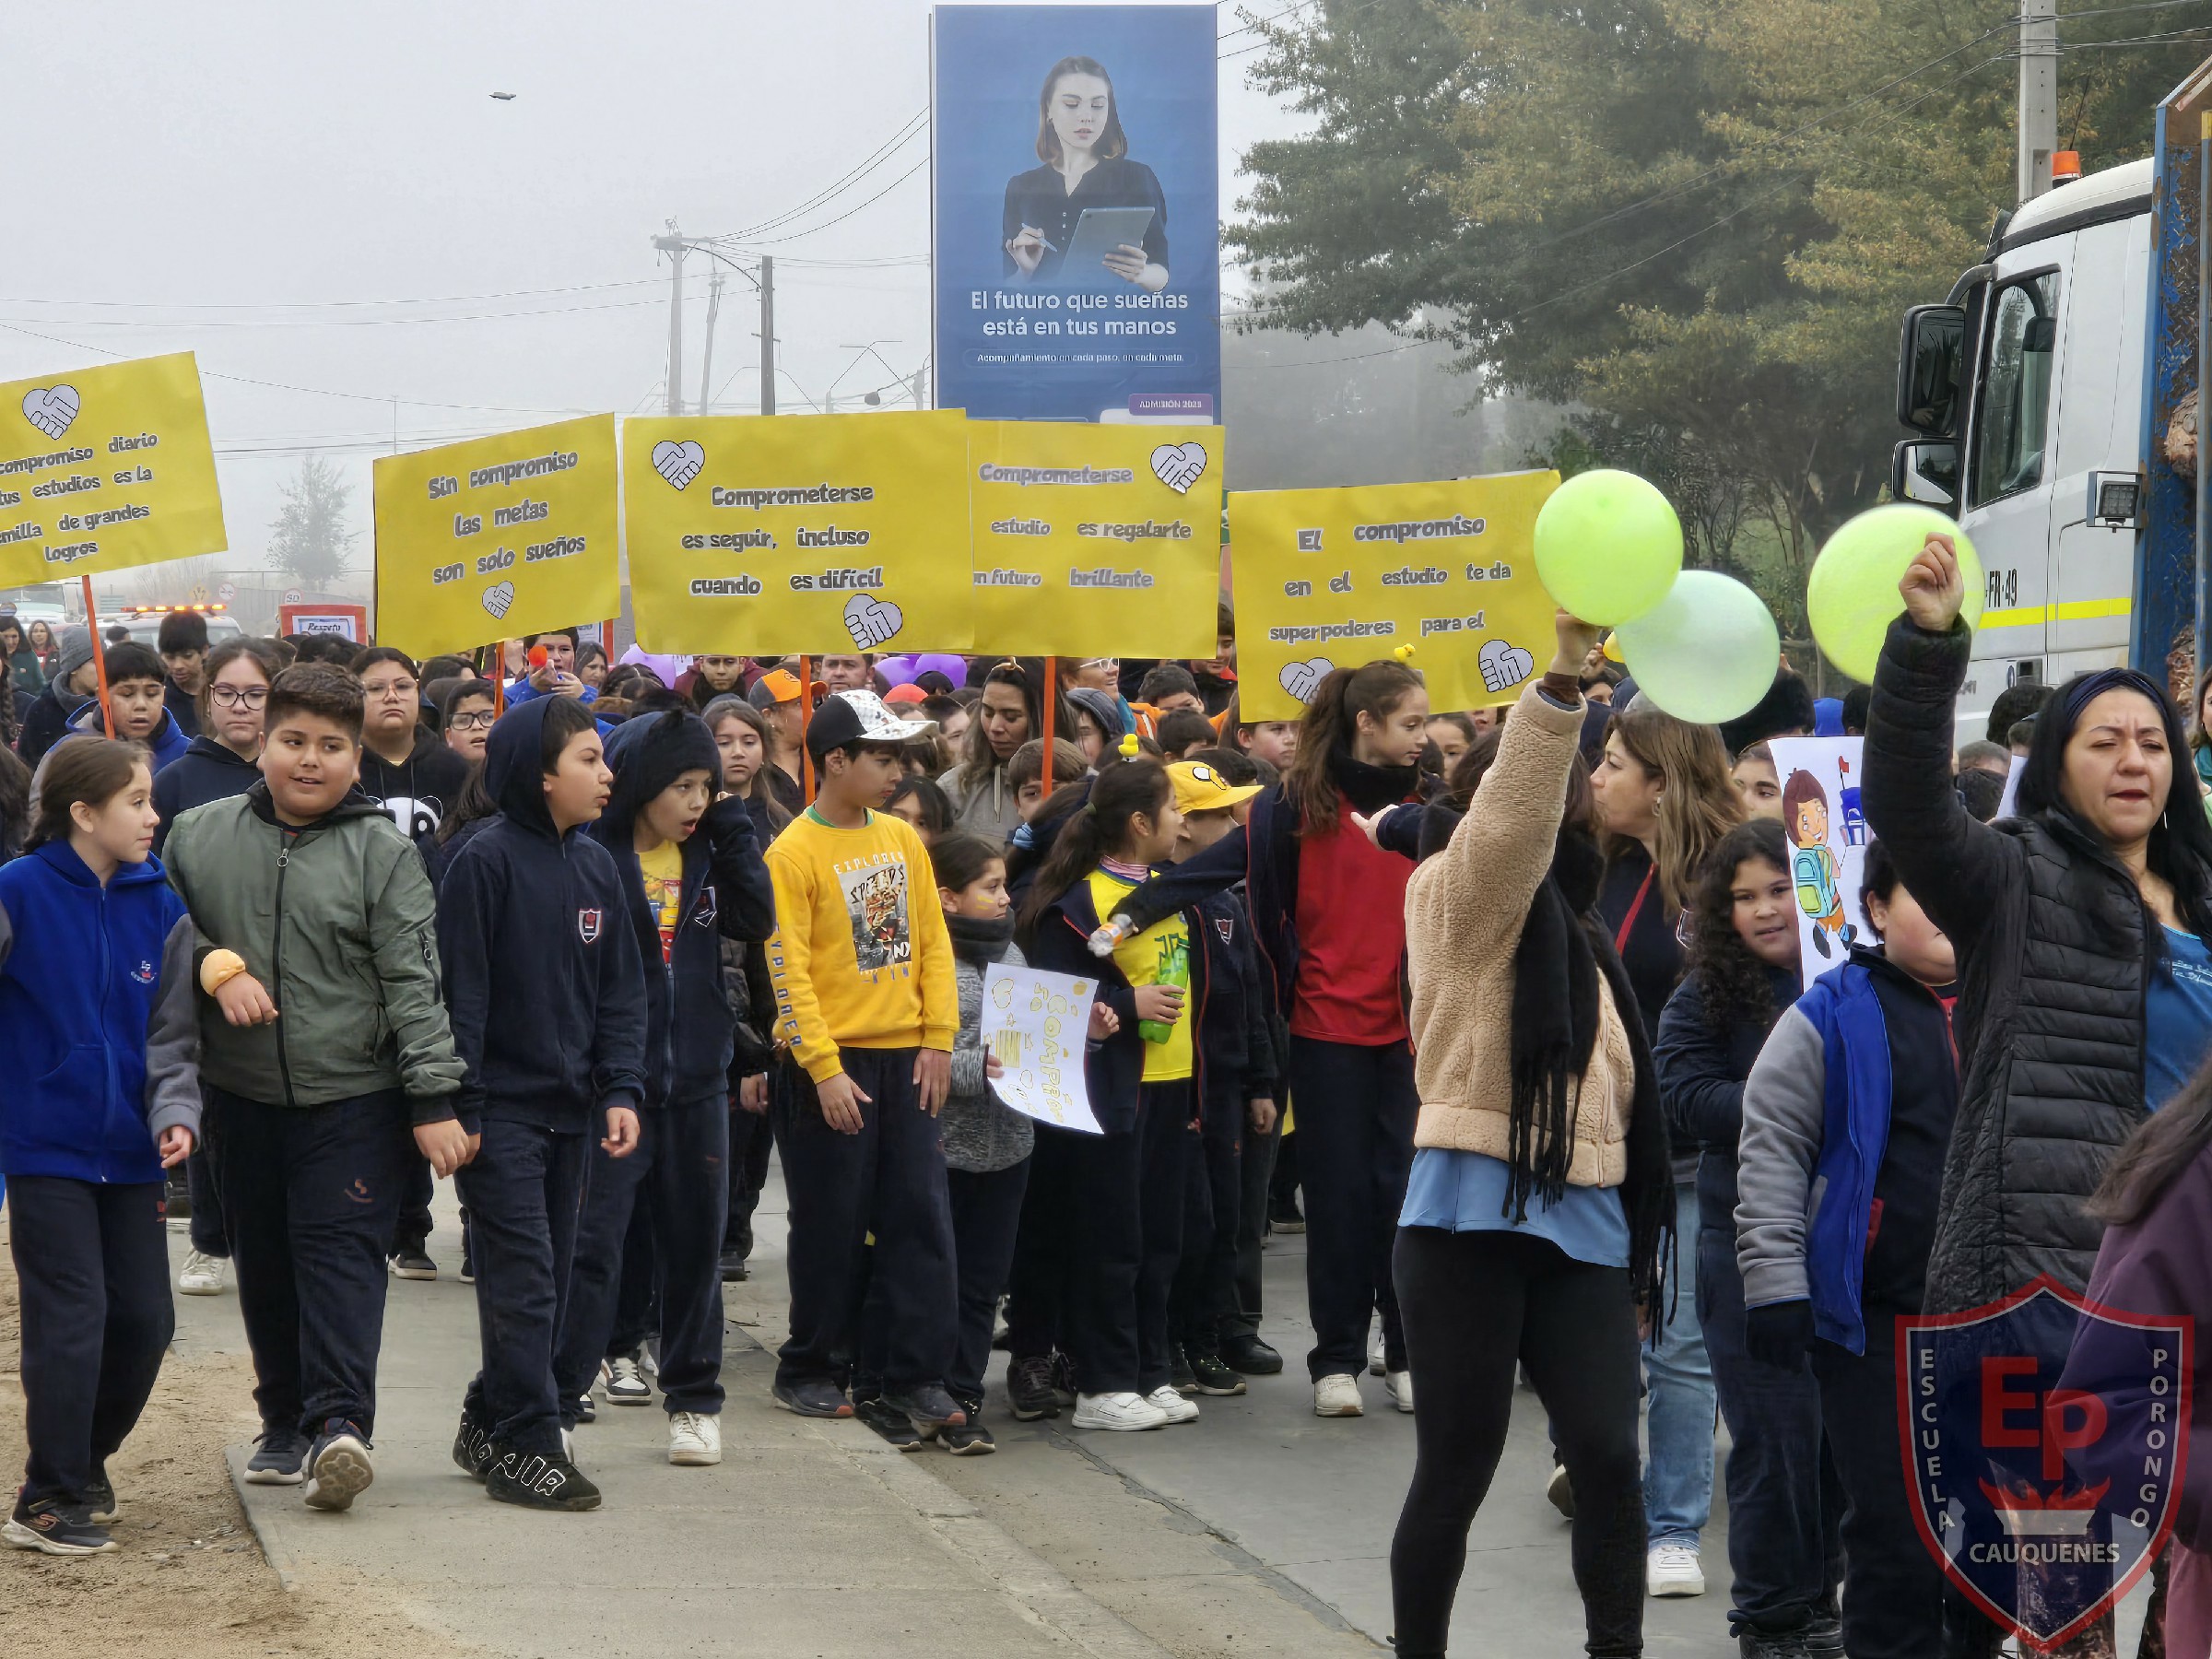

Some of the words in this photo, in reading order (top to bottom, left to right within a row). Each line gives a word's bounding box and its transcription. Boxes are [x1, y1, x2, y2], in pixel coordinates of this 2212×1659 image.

[971, 290, 988, 310] El
[994, 290, 1060, 310] futuro
[1066, 293, 1108, 312] que
[1114, 290, 1189, 309] sueñas
[982, 317, 1028, 335] está
[1034, 321, 1060, 335] en
[1066, 319, 1099, 335] tus
[1105, 320, 1177, 335] manos
[0, 447, 93, 474] compromiso
[108, 433, 158, 453] diario
[0, 490, 20, 506] tus
[32, 476, 100, 498] estudios
[113, 471, 132, 484] es
[136, 465, 152, 482] la
[429, 477, 458, 500] Sin
[470, 452, 578, 485] compromiso
[979, 463, 1133, 486] Comprometerse
[712, 484, 874, 511] Comprometerse
[58, 513, 79, 531] de
[84, 504, 149, 530] grandes
[454, 513, 481, 536] las
[494, 499, 548, 526] metas
[991, 518, 1051, 535] estudio
[1077, 523, 1098, 536] es
[1103, 519, 1192, 542] regalarte
[681, 535, 704, 548] es
[710, 528, 778, 551] seguir,
[796, 526, 870, 547] incluso
[1298, 530, 1322, 551] El
[1353, 514, 1486, 544] compromiso
[45, 541, 98, 562] logros
[433, 562, 465, 583] son
[477, 547, 515, 574] solo
[525, 535, 585, 561] sueños
[690, 575, 761, 595] cuando
[789, 574, 813, 589] es
[992, 569, 1041, 585] futuro
[1069, 568, 1154, 587] brillante
[1284, 582, 1312, 596] en
[1329, 571, 1352, 593] el
[1382, 567, 1448, 585] estudio
[1466, 563, 1484, 581] te
[1489, 561, 1512, 580] da
[1269, 620, 1394, 645] superpoderes
[1421, 616, 1462, 637] para
[1466, 611, 1485, 629] el
